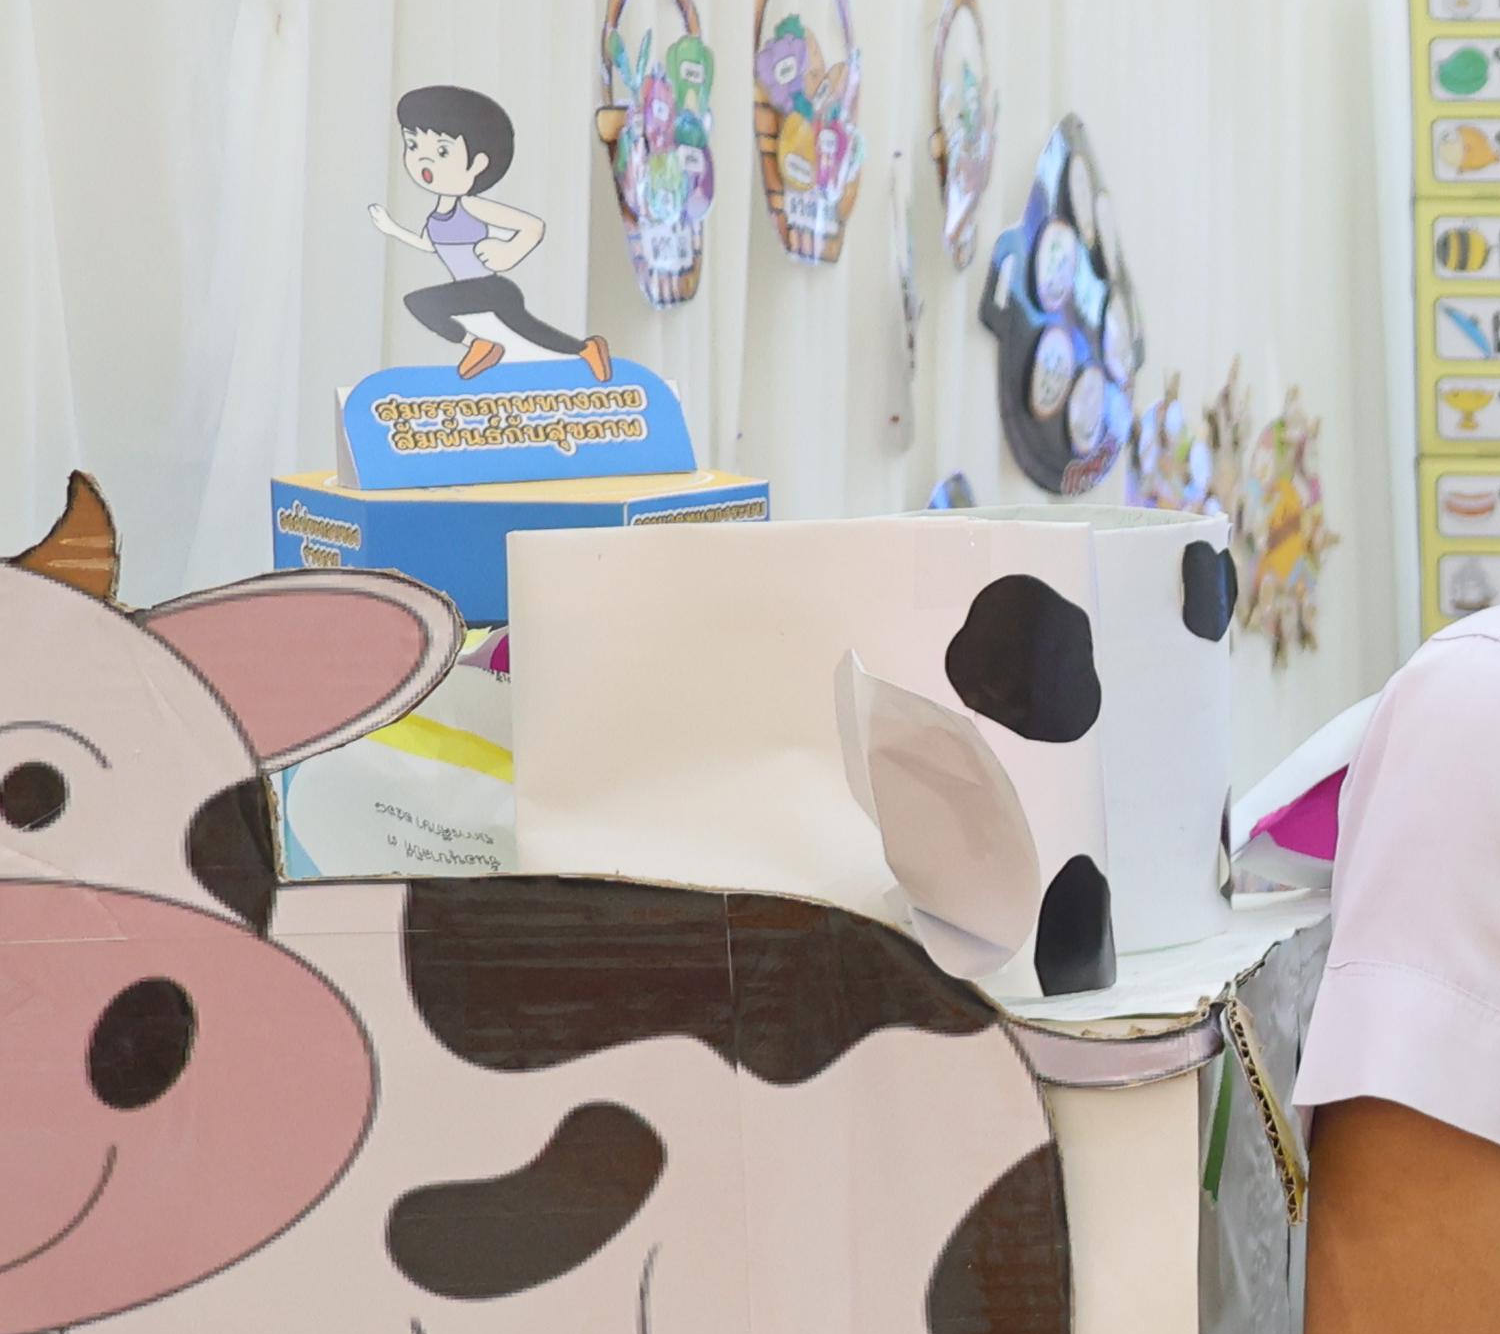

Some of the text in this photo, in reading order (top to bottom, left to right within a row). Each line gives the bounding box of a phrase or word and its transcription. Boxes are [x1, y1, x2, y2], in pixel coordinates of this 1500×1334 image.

[374, 387, 644, 422] สมรรถภาพทางกาย
[391, 414, 644, 453] สัมพันธ์กับสุขภาพ
